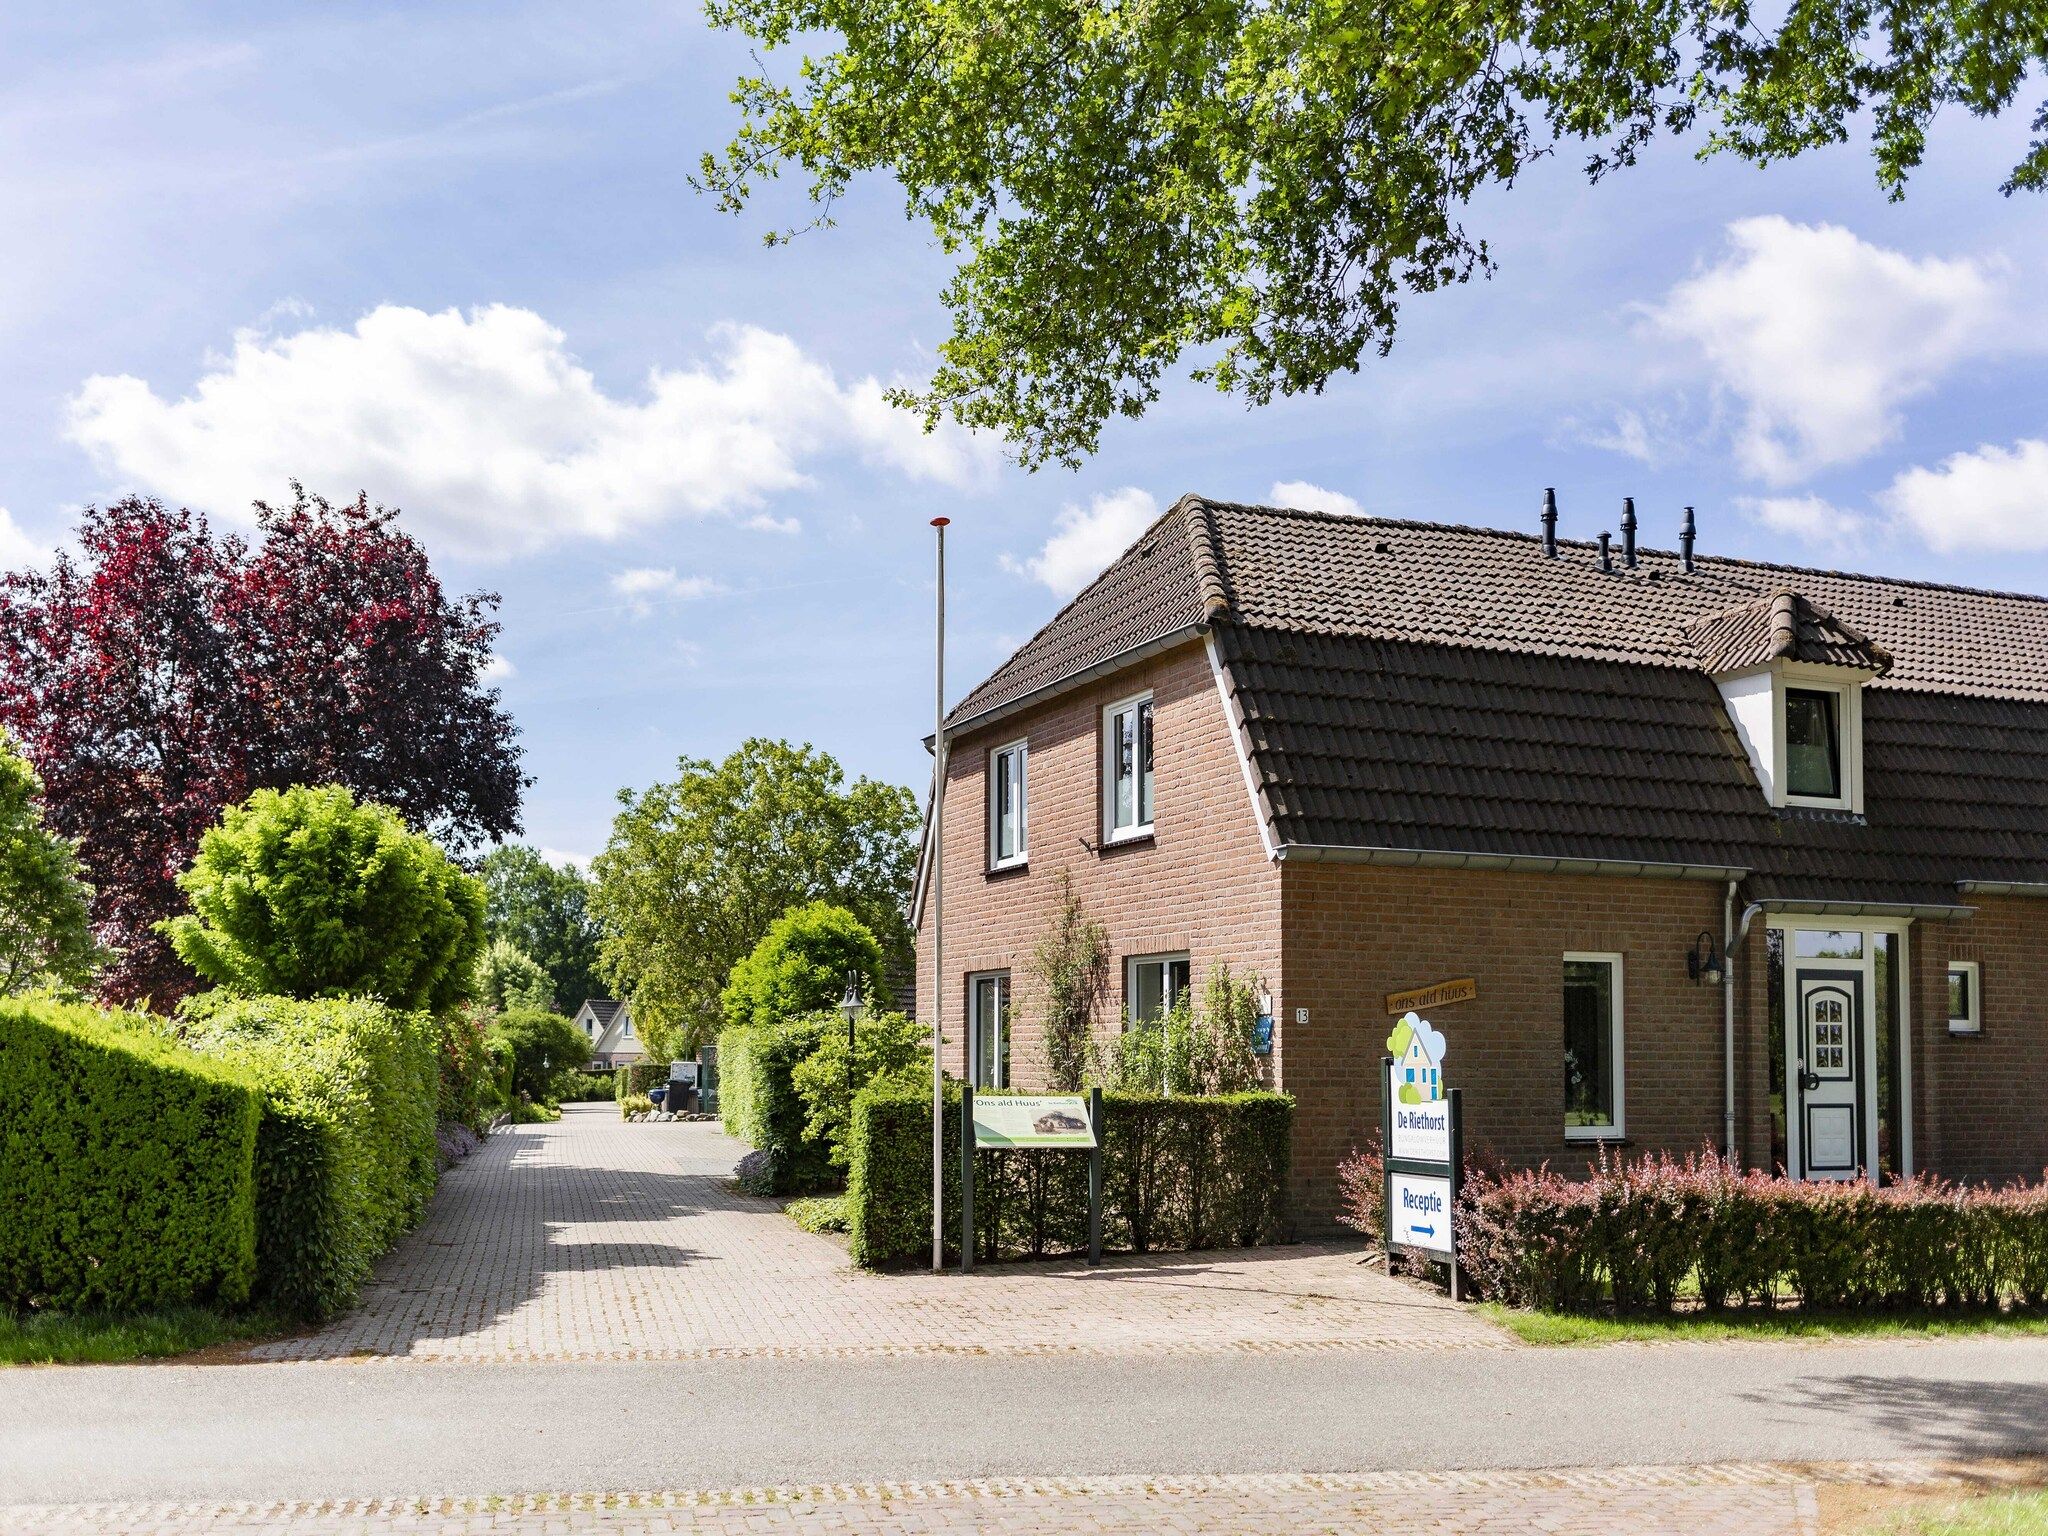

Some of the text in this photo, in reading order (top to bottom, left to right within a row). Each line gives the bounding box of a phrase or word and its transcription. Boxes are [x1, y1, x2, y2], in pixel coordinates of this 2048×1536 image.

[1395, 997, 1415, 1011] ons
[1419, 989, 1437, 1006] ald
[1297, 1009, 1308, 1022] 13
[997, 1099, 1013, 1107] ald
[1397, 1110, 1445, 1131] De Riethorst
[1403, 1187, 1442, 1216] Receptie
